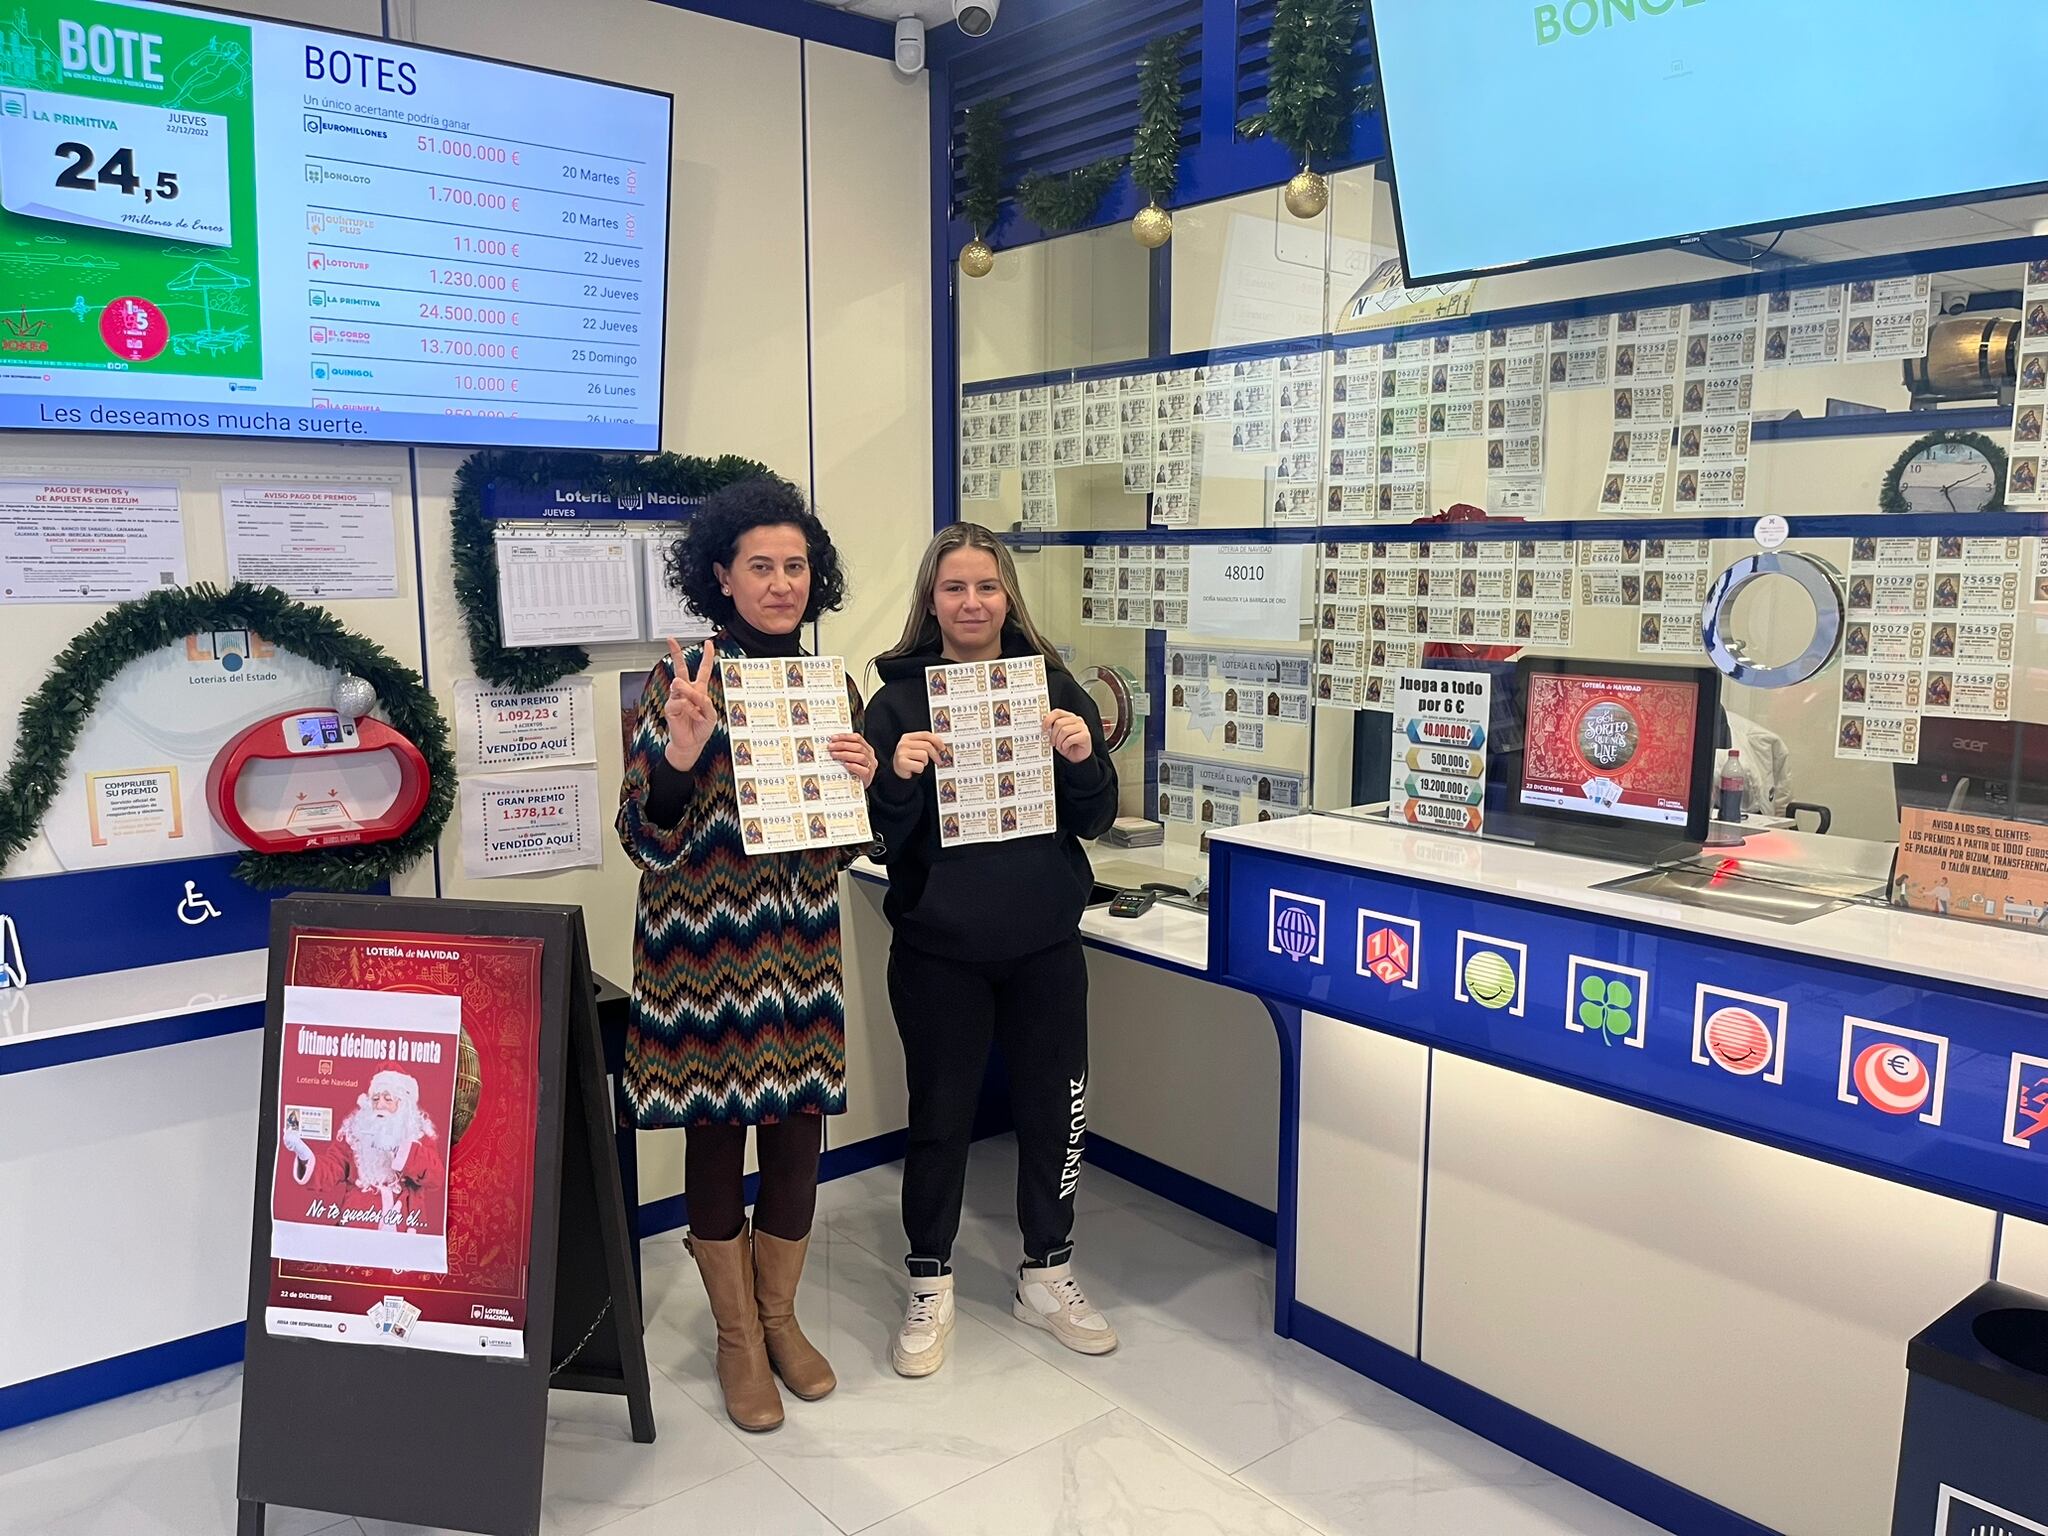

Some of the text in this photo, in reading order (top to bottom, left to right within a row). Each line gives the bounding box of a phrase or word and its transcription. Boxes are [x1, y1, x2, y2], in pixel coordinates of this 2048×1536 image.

[57, 18, 164, 83] BOTE
[304, 45, 418, 96] BOTES
[303, 93, 319, 107] Un
[321, 95, 352, 112] único
[354, 101, 405, 120] acertante
[441, 117, 471, 131] ganar
[32, 111, 118, 131] LA PRIMITIVA
[169, 113, 207, 127] JUEVES
[166, 124, 209, 137] 22/12/2022
[322, 123, 388, 139] EUROMILLONES
[417, 136, 521, 166] 51.000.000 €
[54, 141, 179, 204] 24,5
[324, 170, 371, 185] BONOLOTO
[561, 165, 621, 186] 20 Martes
[626, 168, 637, 194] HOY
[428, 185, 521, 213] 1.700.000 €
[453, 236, 521, 258] 11.000 €
[326, 259, 370, 270] LOTOTURF
[583, 251, 640, 269] 22 Jueves
[429, 269, 520, 292] 1.230.000 €
[418, 303, 520, 327] 24.500.000 €
[1875, 314, 1911, 326] 62574
[340, 330, 371, 340] GORDO
[1710, 333, 1742, 343] 46676
[419, 338, 520, 360] 13.700.000 €
[1636, 343, 1666, 353] 55352
[571, 349, 638, 367] 25 Domingo
[331, 368, 374, 378] QUINIGOL
[454, 375, 520, 393] 10.000 €
[587, 382, 637, 397] 26 Lunes
[40, 403, 368, 436] Les deseamos mucha suerte.
[44, 486, 69, 494] PAGO
[84, 487, 123, 495] PREMIOS
[49, 495, 93, 503] APUESTAS
[111, 496, 139, 504] BIZUM
[542, 509, 576, 517] JUEVES
[1224, 565, 1265, 581] 48010
[1963, 575, 2001, 584] 75459
[1875, 576, 1912, 586] 05079
[1872, 624, 1909, 633] 05079
[1959, 625, 1997, 634] 75459
[742, 662, 770, 670] 89043
[1222, 660, 1276, 672] LOTERÍA EL NIÑO
[229, 673, 244, 683] del
[246, 672, 278, 682] Estado
[1400, 676, 1483, 696] Juega a todo
[490, 696, 559, 708] GRAN PREMIO
[1418, 698, 1465, 714] por 6 €
[497, 708, 558, 723] 1.092,23 €
[1423, 722, 1472, 740] 40.000.000 €
[486, 737, 568, 754] VENDIDO AQUÍ
[1952, 738, 1988, 752] acer
[1431, 753, 1470, 768] 500.000 €
[104, 779, 158, 790] COMPRUEBE
[121, 786, 159, 796] PREMIO
[1420, 778, 1469, 796] 19.200.000 €
[496, 793, 566, 806] GRAN PREMIO
[503, 806, 564, 820] 1.378,12 €
[1417, 804, 1468, 822] 13.300.000 €
[1932, 819, 1953, 831] AVISO
[1955, 822, 1960, 831] A
[1961, 823, 1975, 834] LOS
[1995, 829, 2032, 842] CLIENTES:
[1909, 830, 2048, 860] LOS PREMIOS A PARTIR DE 1000 EUROS
[1904, 843, 1913, 852] SE
[1915, 842, 1947, 857] PAGARÁN
[1949, 848, 1964, 860] POR
[1966, 851, 1991, 865] BIZUM,
[1941, 860, 2010, 881] O TALÓN BANCARIO.
[366, 946, 460, 961] LOTERÍA de NAVIDAD
[297, 1025, 442, 1064] Últimos décimos a la venta
[321, 1077, 330, 1086] de
[331, 1078, 359, 1088] Navidad
[306, 1199, 326, 1218] No
[327, 1202, 340, 1219] te
[340, 1206, 382, 1226] quedes
[383, 1208, 404, 1225] sin
[280, 1290, 333, 1302] 22 de DICIEMBRE
[484, 1314, 515, 1323] NACIONAL
[485, 1307, 509, 1316] LOTERÍA
